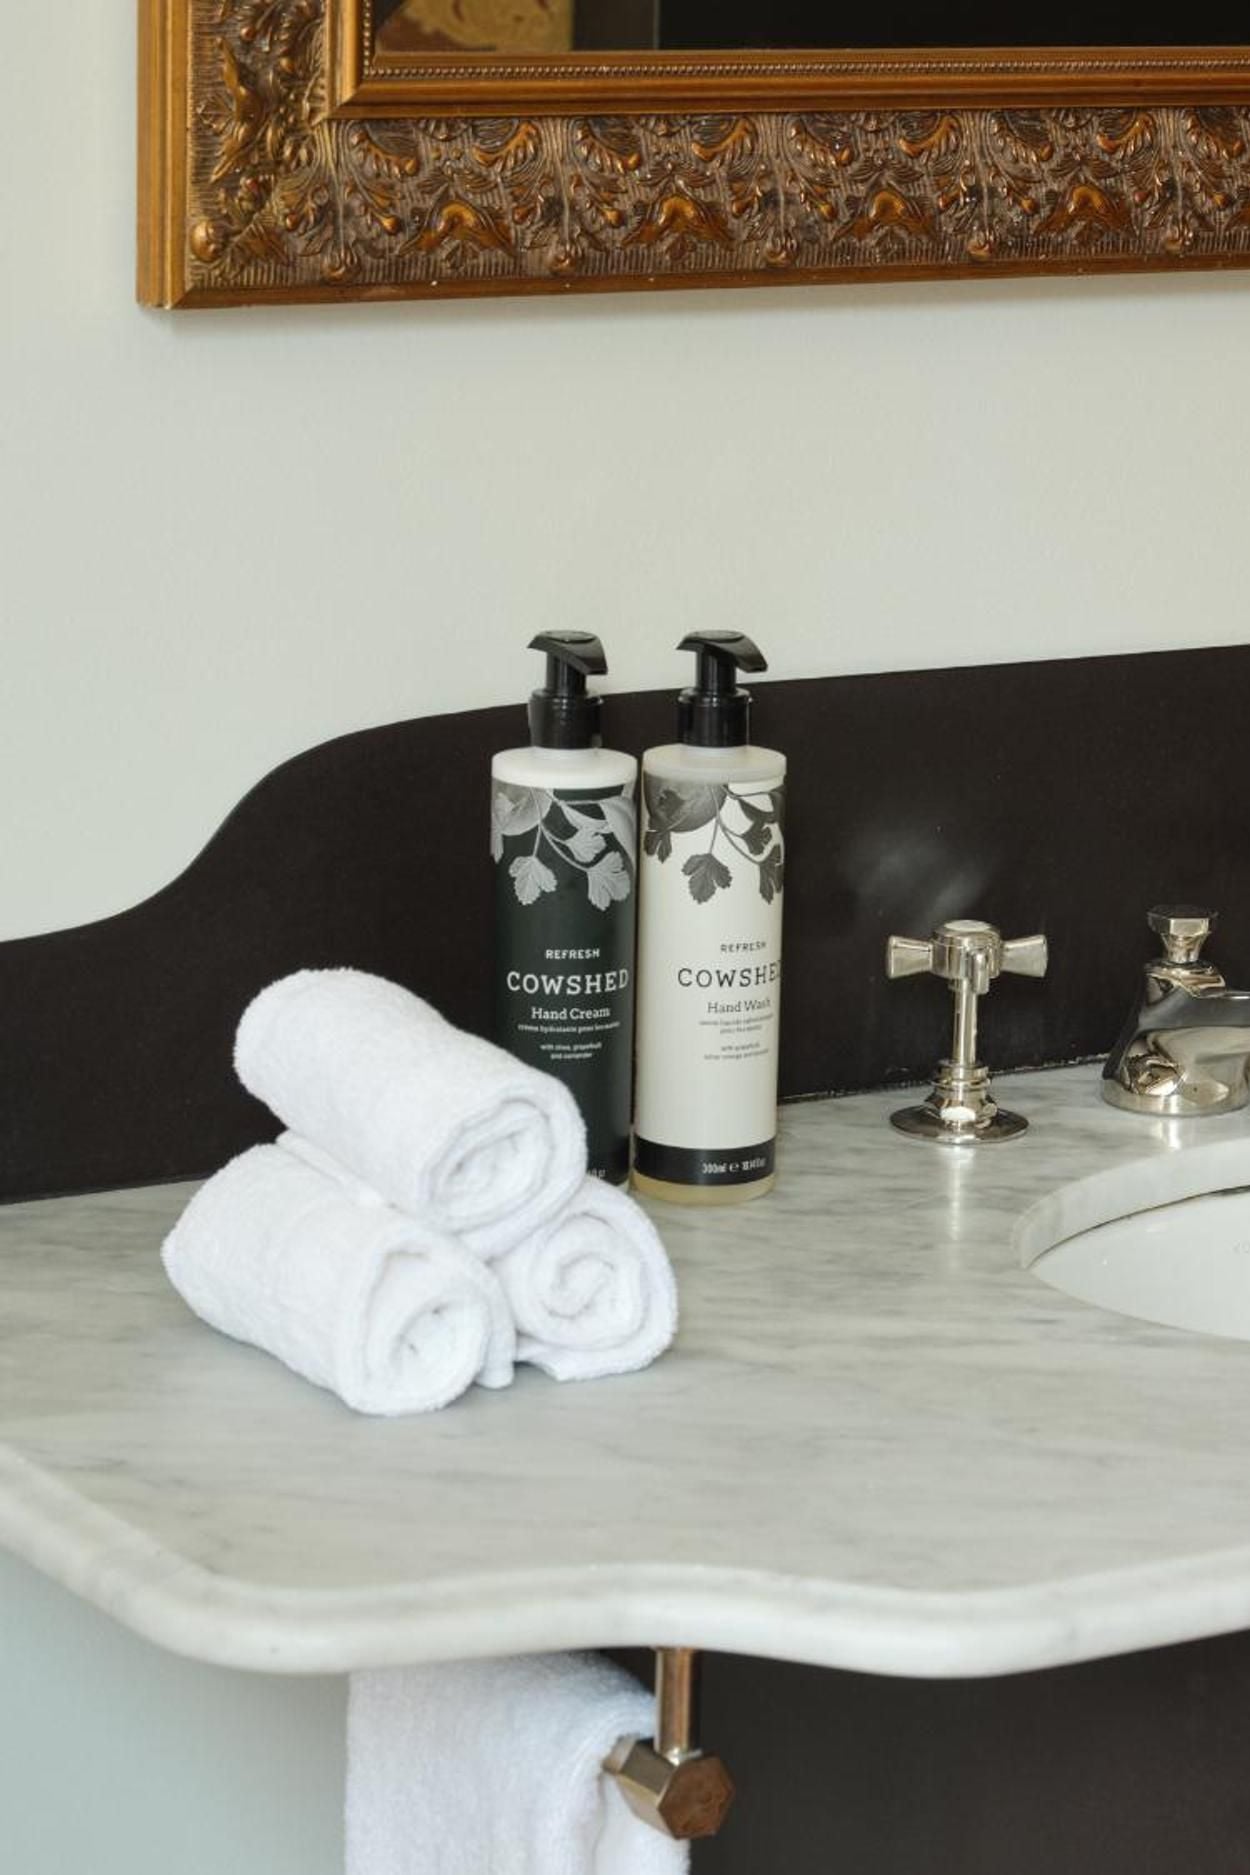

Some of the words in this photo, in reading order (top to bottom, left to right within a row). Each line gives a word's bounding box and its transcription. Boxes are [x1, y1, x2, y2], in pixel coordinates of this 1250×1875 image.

[545, 947, 600, 961] REFRESH
[720, 941, 767, 953] REFRESH
[506, 968, 629, 996] COWSHED
[531, 1006, 568, 1021] Hand
[569, 1006, 611, 1021] Cream
[707, 1000, 741, 1014] Hand
